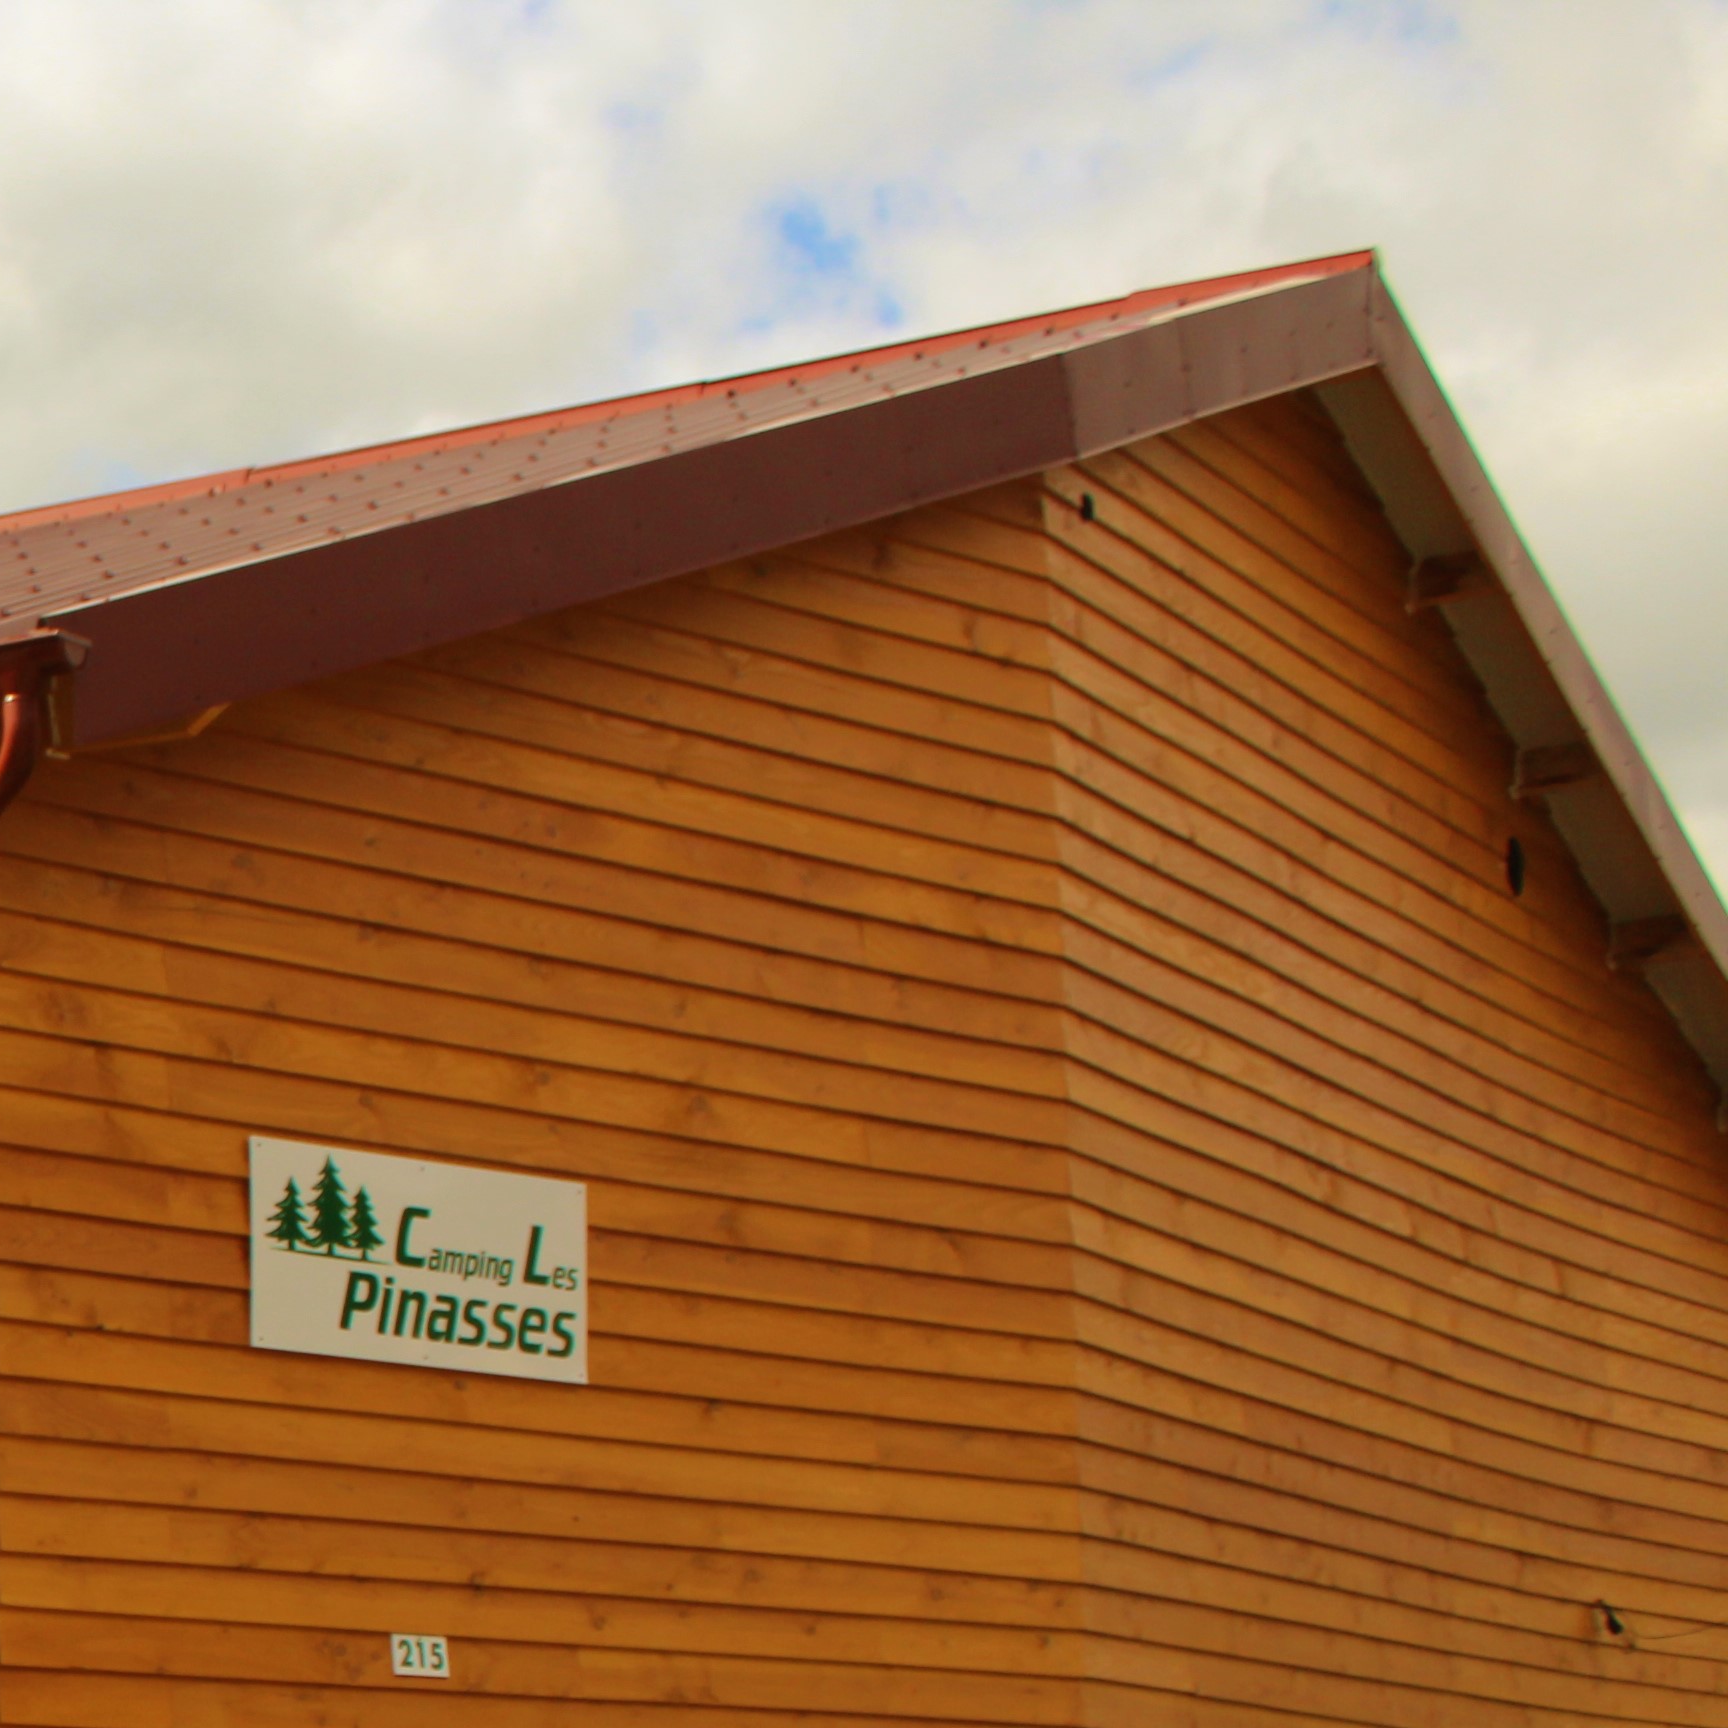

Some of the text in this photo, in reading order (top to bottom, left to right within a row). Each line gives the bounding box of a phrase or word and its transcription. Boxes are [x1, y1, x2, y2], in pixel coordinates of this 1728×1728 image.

[395, 1206, 579, 1291] Camping Les
[339, 1270, 578, 1359] Pinasses
[399, 1639, 445, 1670] 215
